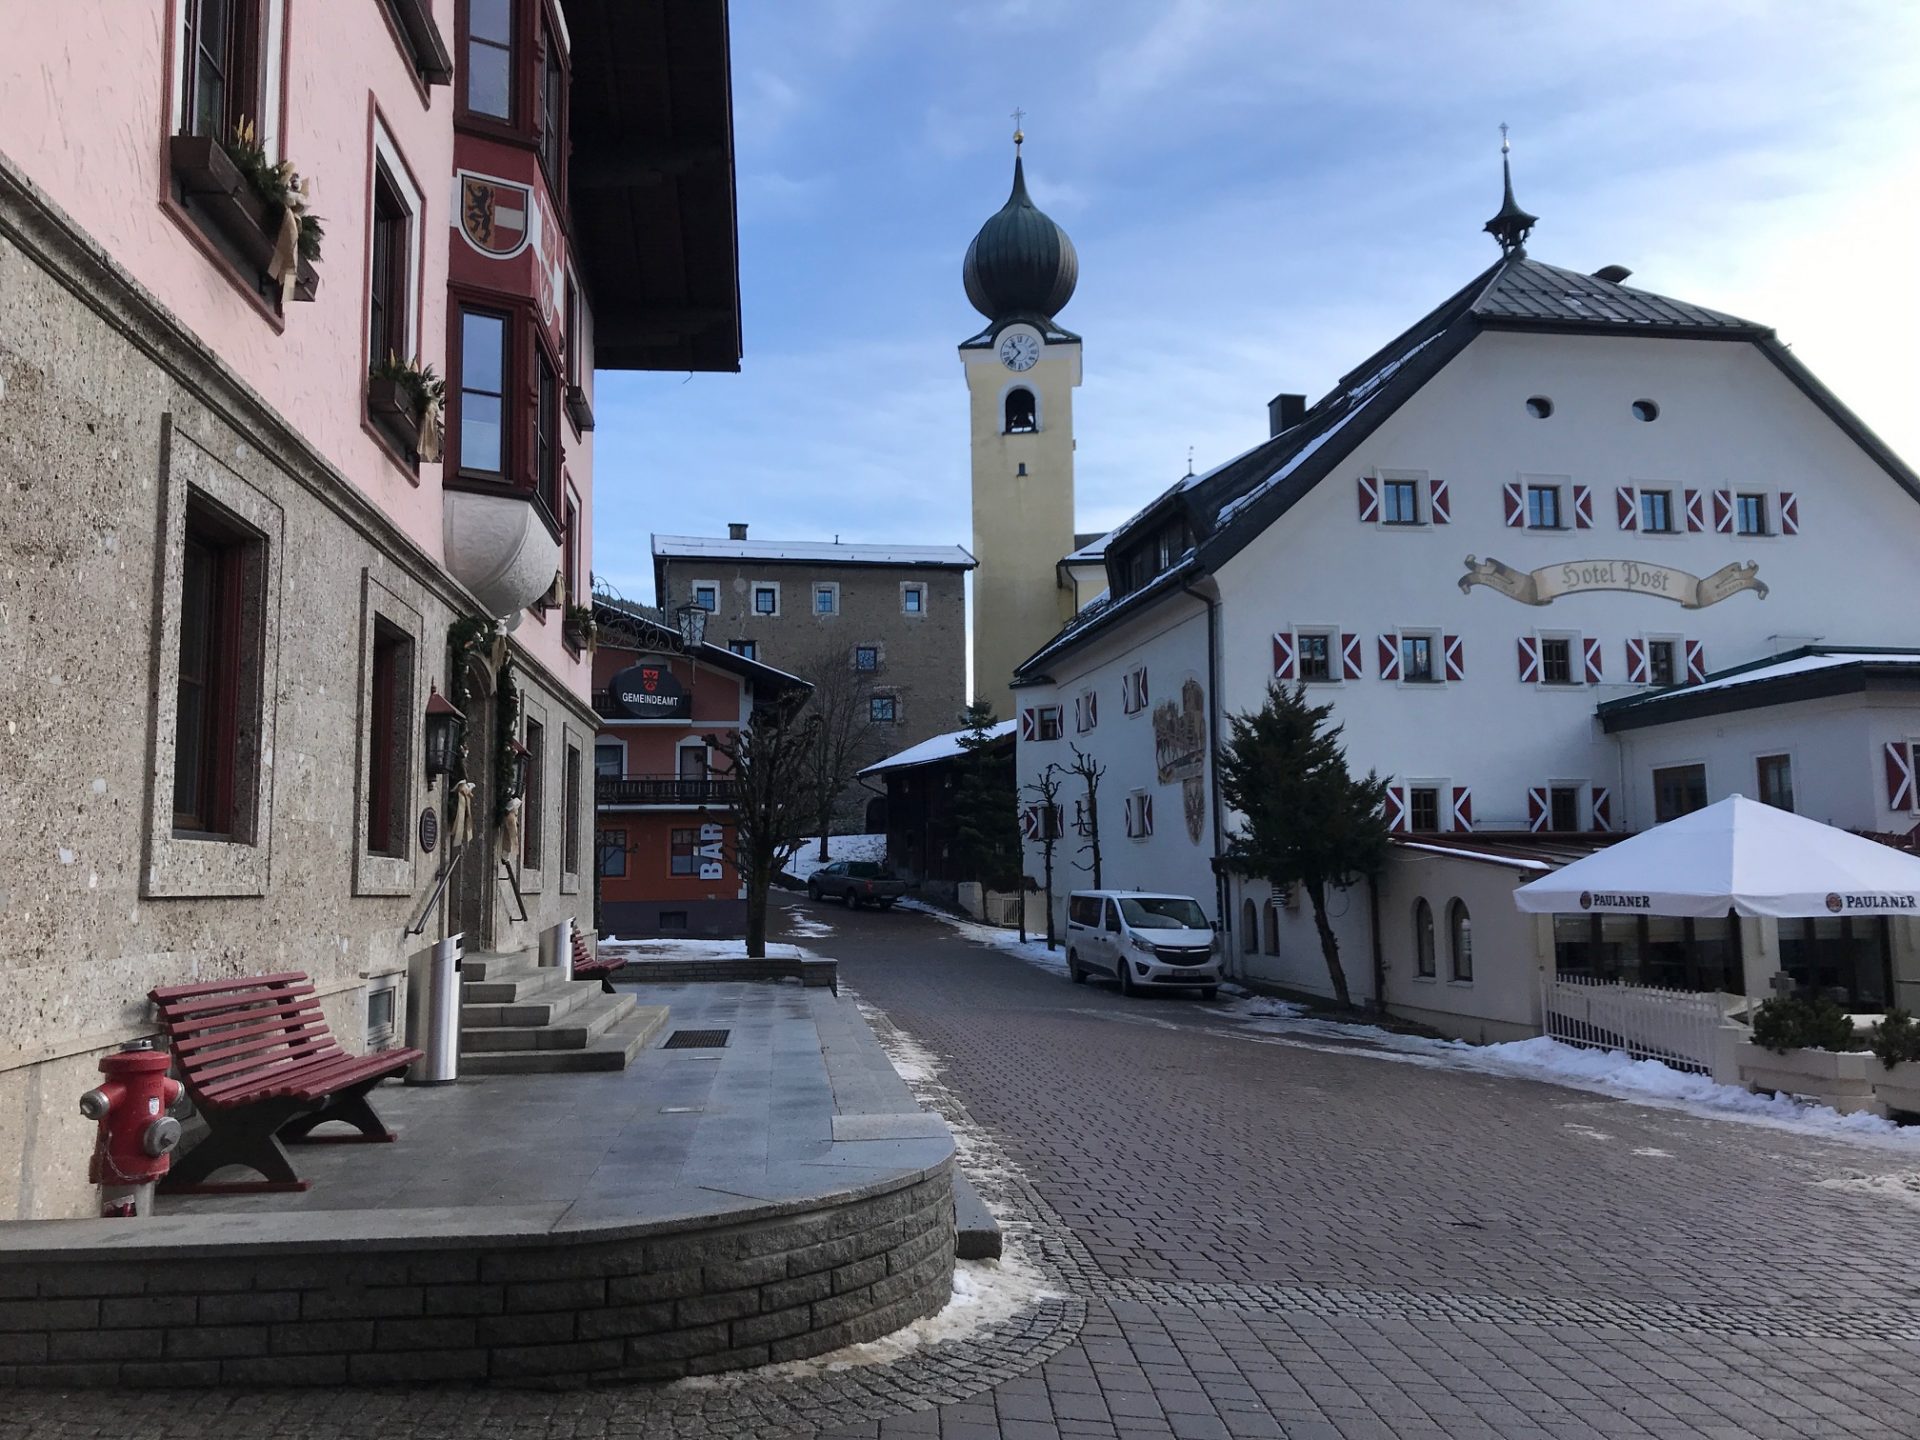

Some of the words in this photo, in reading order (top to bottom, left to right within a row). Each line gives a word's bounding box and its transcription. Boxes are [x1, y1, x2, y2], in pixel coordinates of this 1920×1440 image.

[1561, 562, 1617, 591] Hotel
[1622, 561, 1670, 591] Post
[622, 692, 679, 706] GEMEINDEAMT
[699, 822, 723, 880] BAR
[1593, 893, 1651, 908] PAULANER
[1845, 895, 1917, 908] PAULANER
